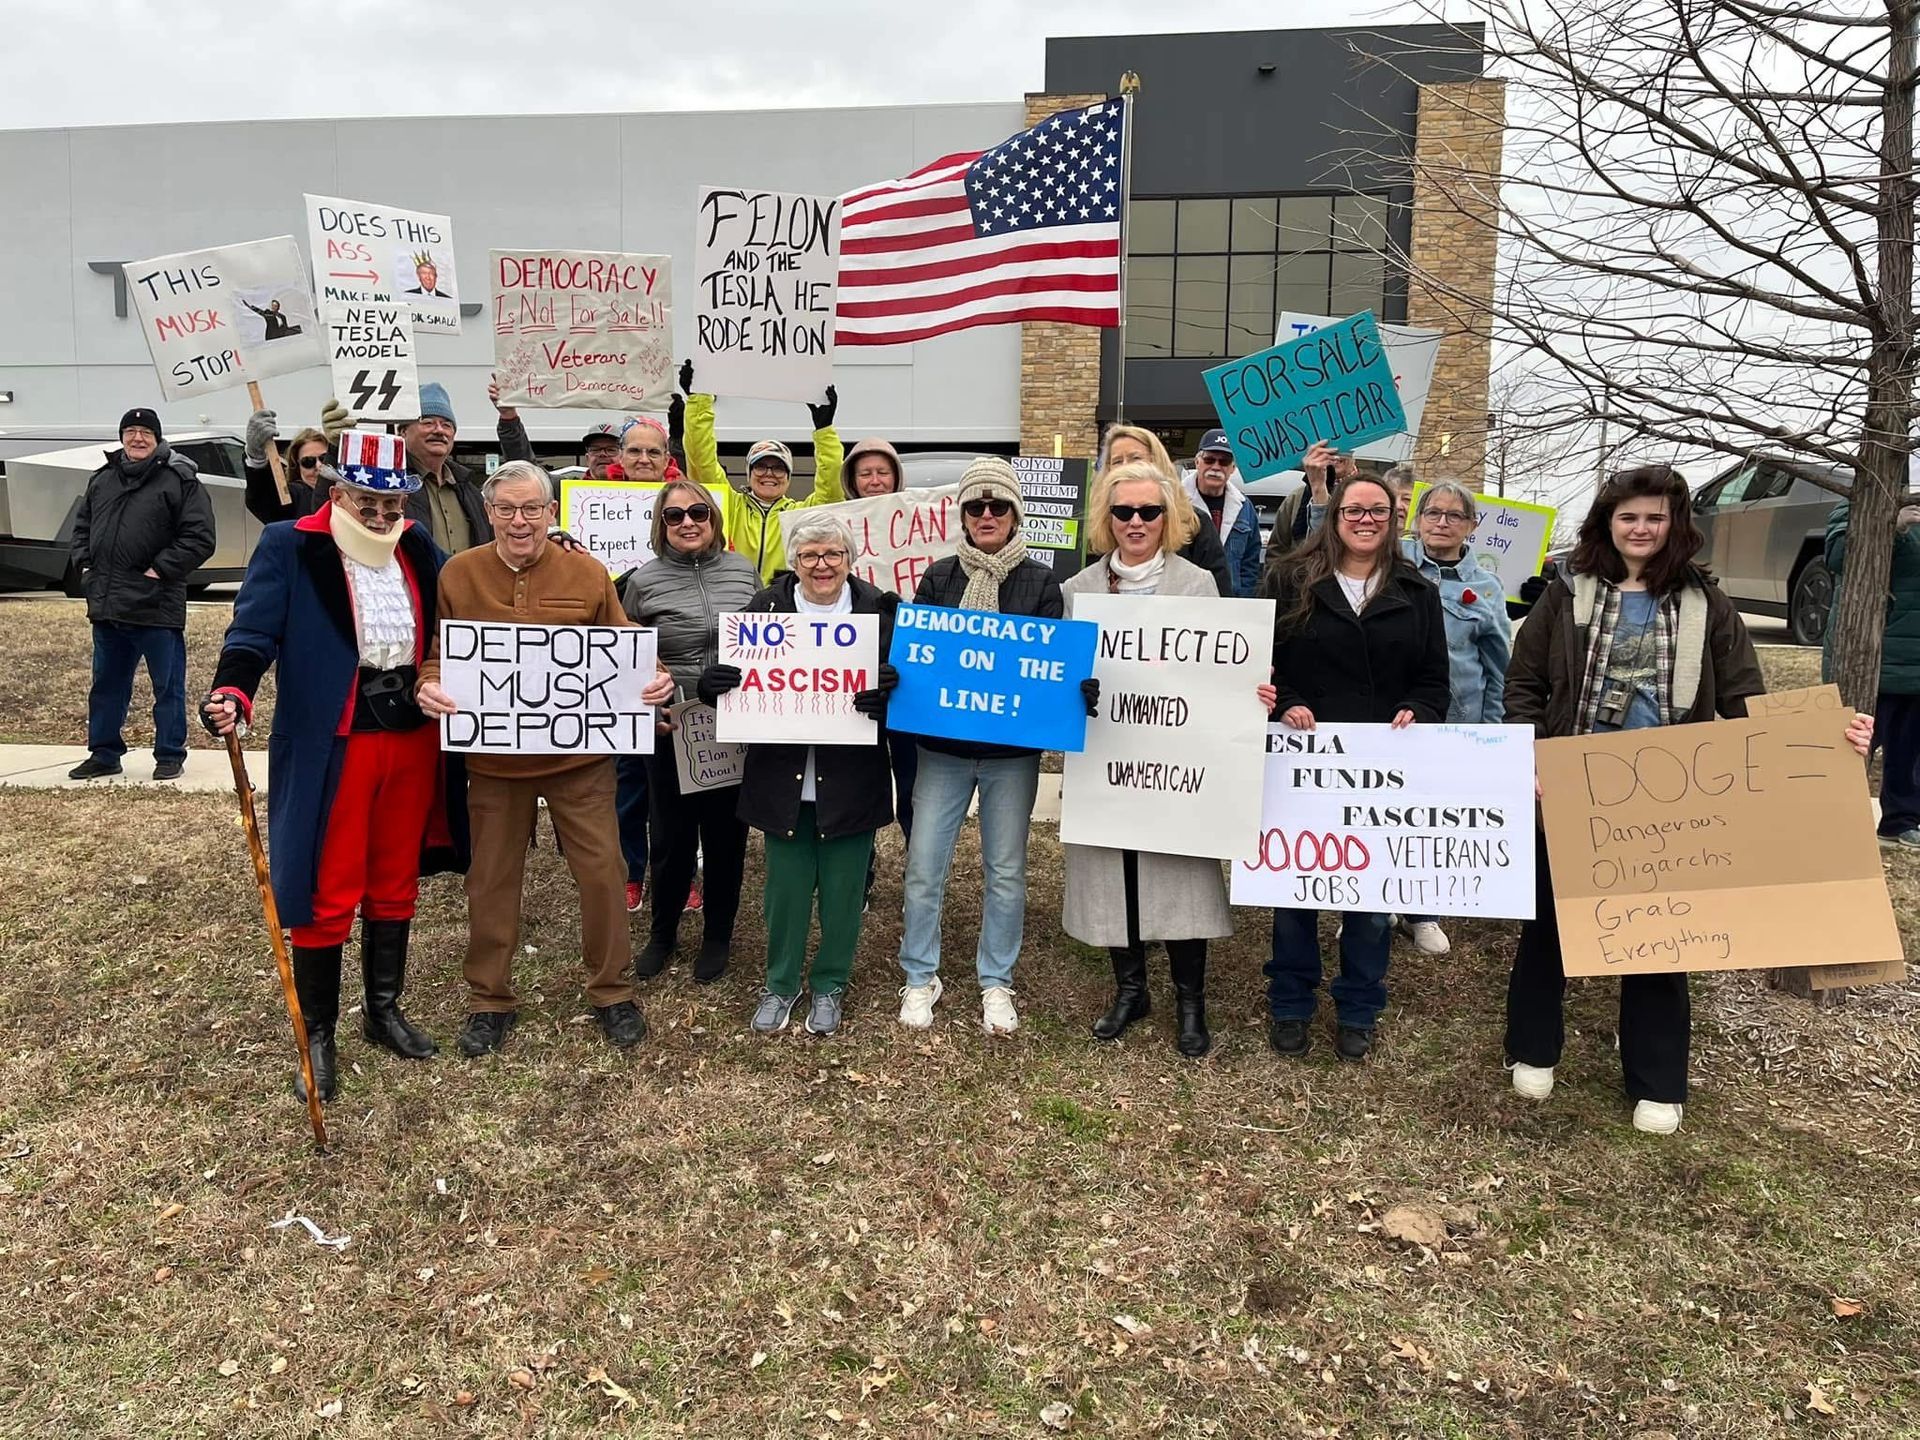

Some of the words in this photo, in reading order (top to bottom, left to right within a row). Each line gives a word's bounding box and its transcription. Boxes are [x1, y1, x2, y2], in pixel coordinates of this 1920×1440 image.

[319, 207, 387, 238] DOES
[391, 219, 441, 244] THIS
[326, 239, 373, 262] ASS
[723, 250, 759, 272] AND
[766, 251, 802, 273] THE
[138, 266, 221, 302] THIS
[500, 257, 656, 296] DEMOCRACY
[700, 270, 783, 316] TESLA
[795, 280, 831, 312] HE
[346, 309, 398, 326] NEW
[495, 294, 516, 325] Is
[520, 291, 555, 324] Not
[571, 294, 597, 325] For
[607, 300, 664, 329] Sale!!
[155, 309, 226, 342] MUSK
[332, 326, 407, 343] TESLA
[698, 314, 753, 354] RODE
[760, 317, 786, 356] IN
[793, 320, 826, 355] ON
[335, 345, 408, 359] MODEL
[542, 340, 627, 371] Veterans
[172, 350, 246, 386] STOP!
[526, 372, 547, 399] for
[566, 372, 644, 400] Democracy
[1238, 382, 1396, 468] SWASTICAR
[1013, 459, 1029, 469] SO
[1034, 460, 1062, 470] YOU
[1017, 472, 1059, 483] VOTED
[1032, 486, 1077, 497] TRUMP
[590, 503, 632, 521] Elect
[1021, 519, 1048, 529] LON
[1052, 521, 1062, 530] IS
[1040, 504, 1070, 515] NOW
[1496, 508, 1519, 527] dies
[590, 535, 637, 558] Expect
[1486, 533, 1511, 554] stay
[739, 623, 784, 646] NO
[810, 623, 856, 647] TO
[897, 608, 1056, 644] DEMOCRACY
[446, 624, 652, 669] DEPORT
[1101, 627, 1249, 664] NELECTED
[907, 643, 935, 664] IS
[959, 649, 995, 671] ON
[1019, 658, 1065, 682] THE
[480, 670, 618, 709] MUSK
[741, 668, 866, 693] ASCISM
[939, 688, 1021, 717] LINE!
[1111, 692, 1189, 727] UNWANTED
[447, 710, 649, 750] DEPORT
[689, 710, 713, 726] It's
[698, 750, 728, 763] Elon
[1265, 733, 1345, 754] ESLA
[1107, 761, 1205, 794] UNAMERICAN
[1292, 768, 1405, 789] FUNDS
[1582, 731, 1768, 807] DOGE
[1343, 805, 1505, 829] FASCISTS
[1589, 814, 1728, 853] Dangerous
[1387, 836, 1510, 869] VETERANS
[1592, 848, 1732, 892] Oligarchs
[1294, 875, 1361, 905] JOBS
[1595, 897, 1692, 931] Grab
[1598, 928, 1731, 964] Everything
